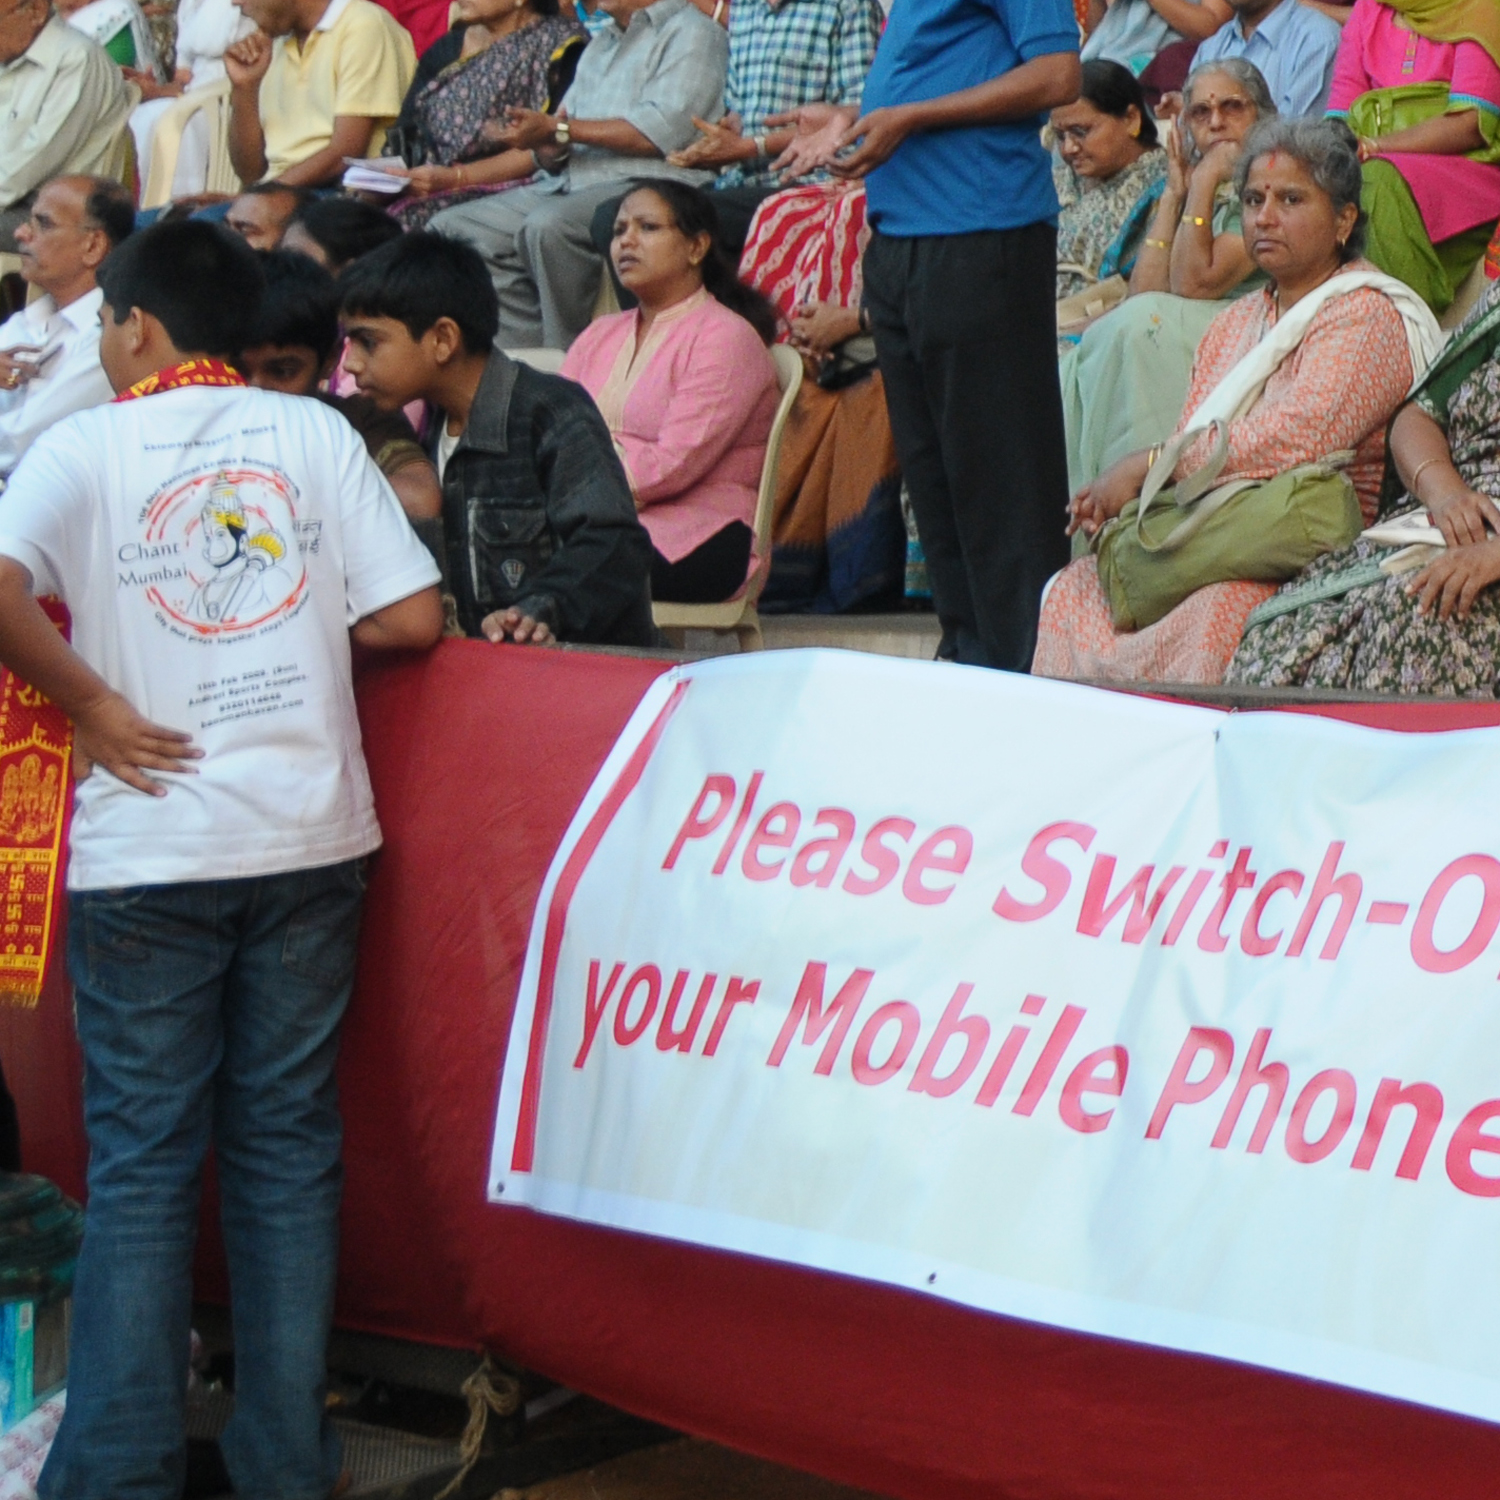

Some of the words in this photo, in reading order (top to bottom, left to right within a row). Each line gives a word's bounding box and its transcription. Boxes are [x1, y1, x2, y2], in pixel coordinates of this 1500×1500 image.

[118, 542, 180, 563] Chant
[118, 562, 187, 588] Mumbai
[662, 771, 972, 906] Please
[573, 959, 763, 1070] your
[766, 960, 1131, 1135] Mobile
